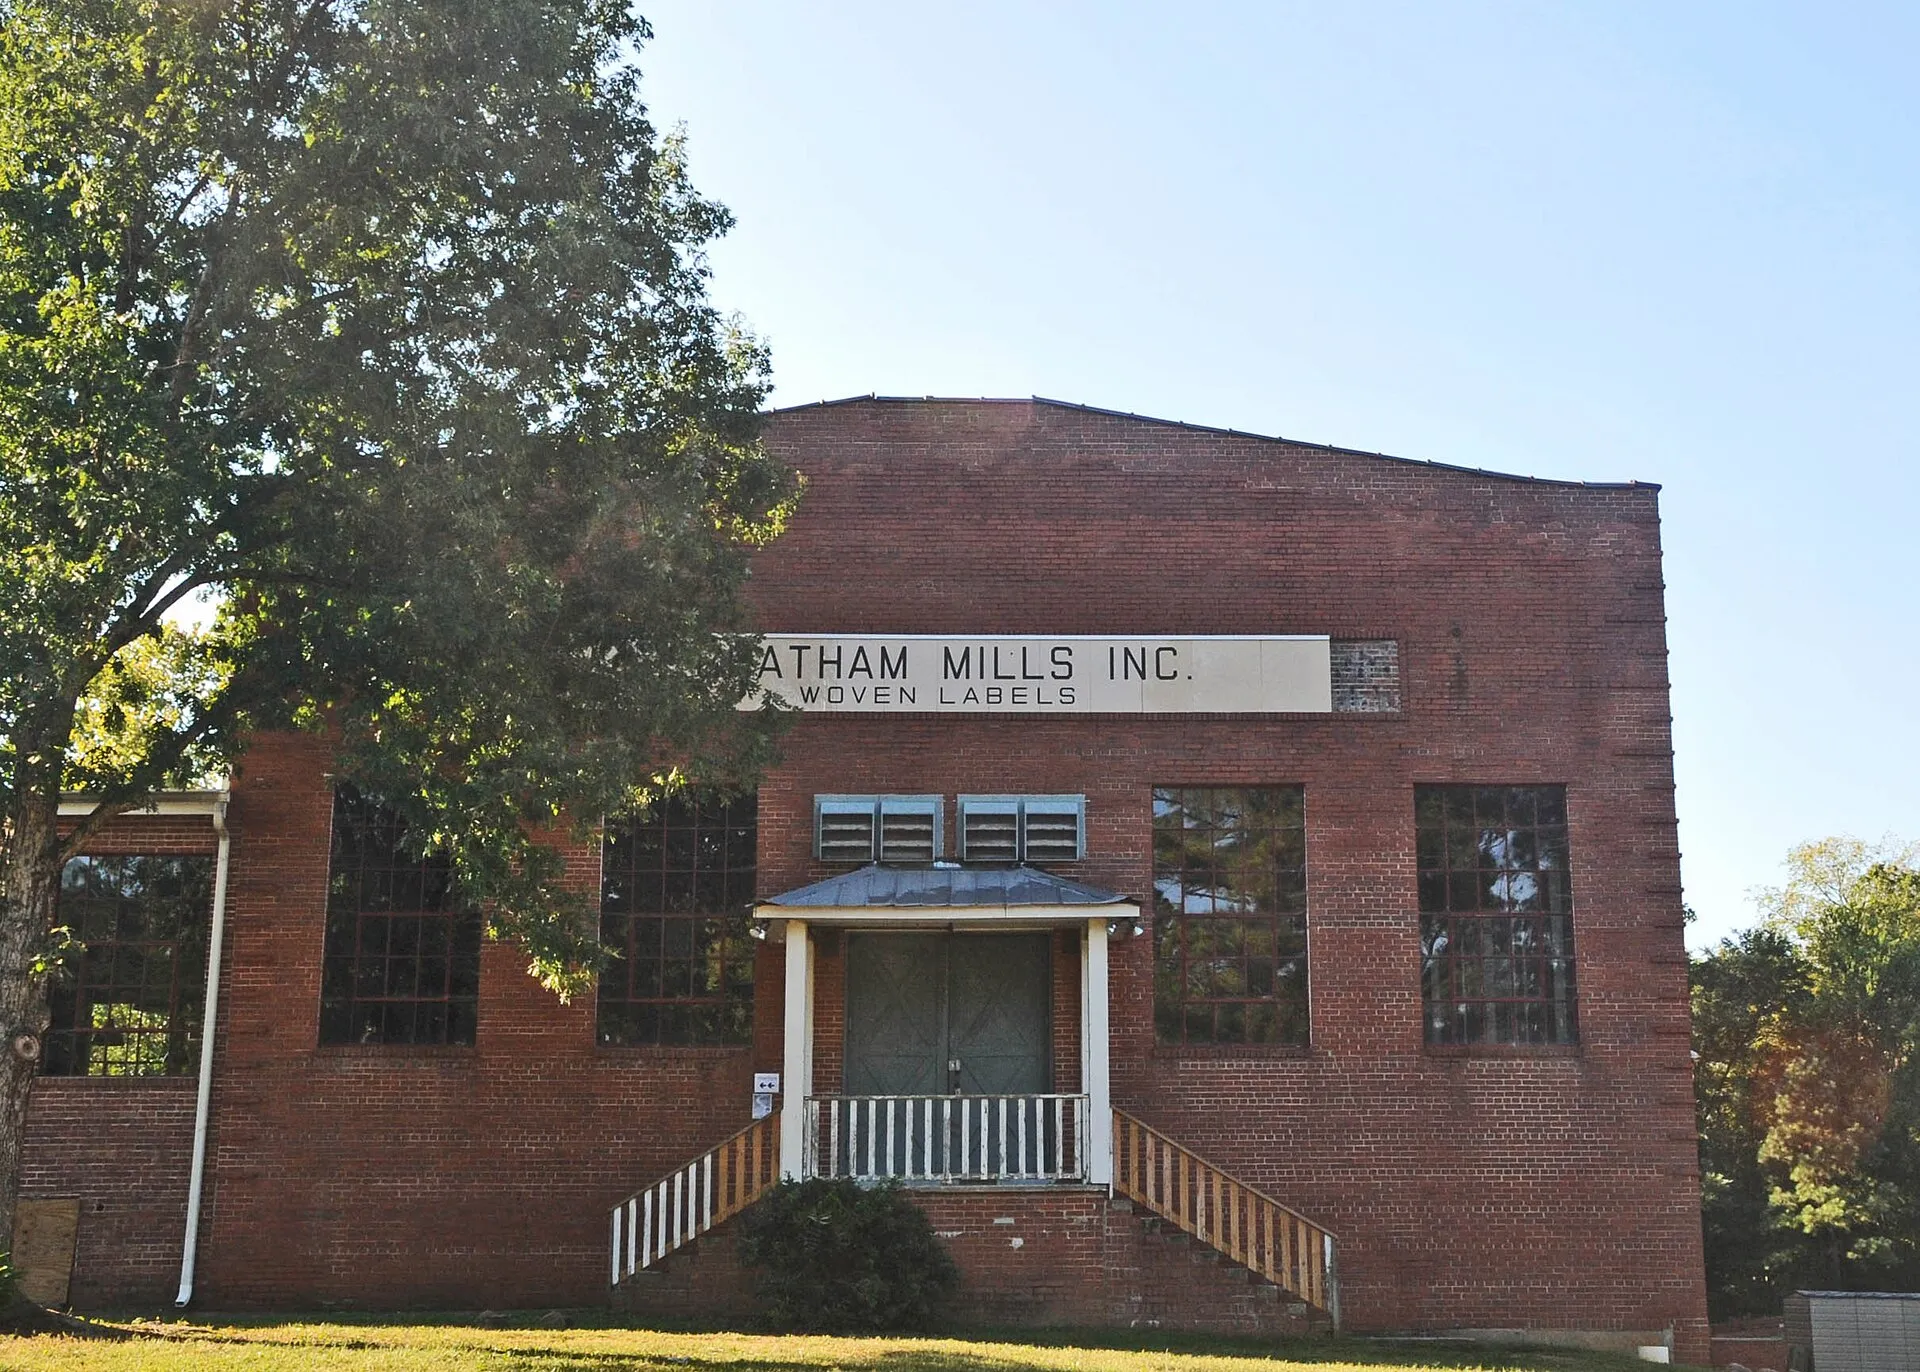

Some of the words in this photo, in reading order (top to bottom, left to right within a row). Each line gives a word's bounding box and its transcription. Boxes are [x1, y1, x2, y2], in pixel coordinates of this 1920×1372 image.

[943, 645, 1073, 680] MILLS
[1109, 645, 1193, 680] INC.
[799, 685, 916, 704] WOVEN
[939, 686, 1076, 705] LABELS
